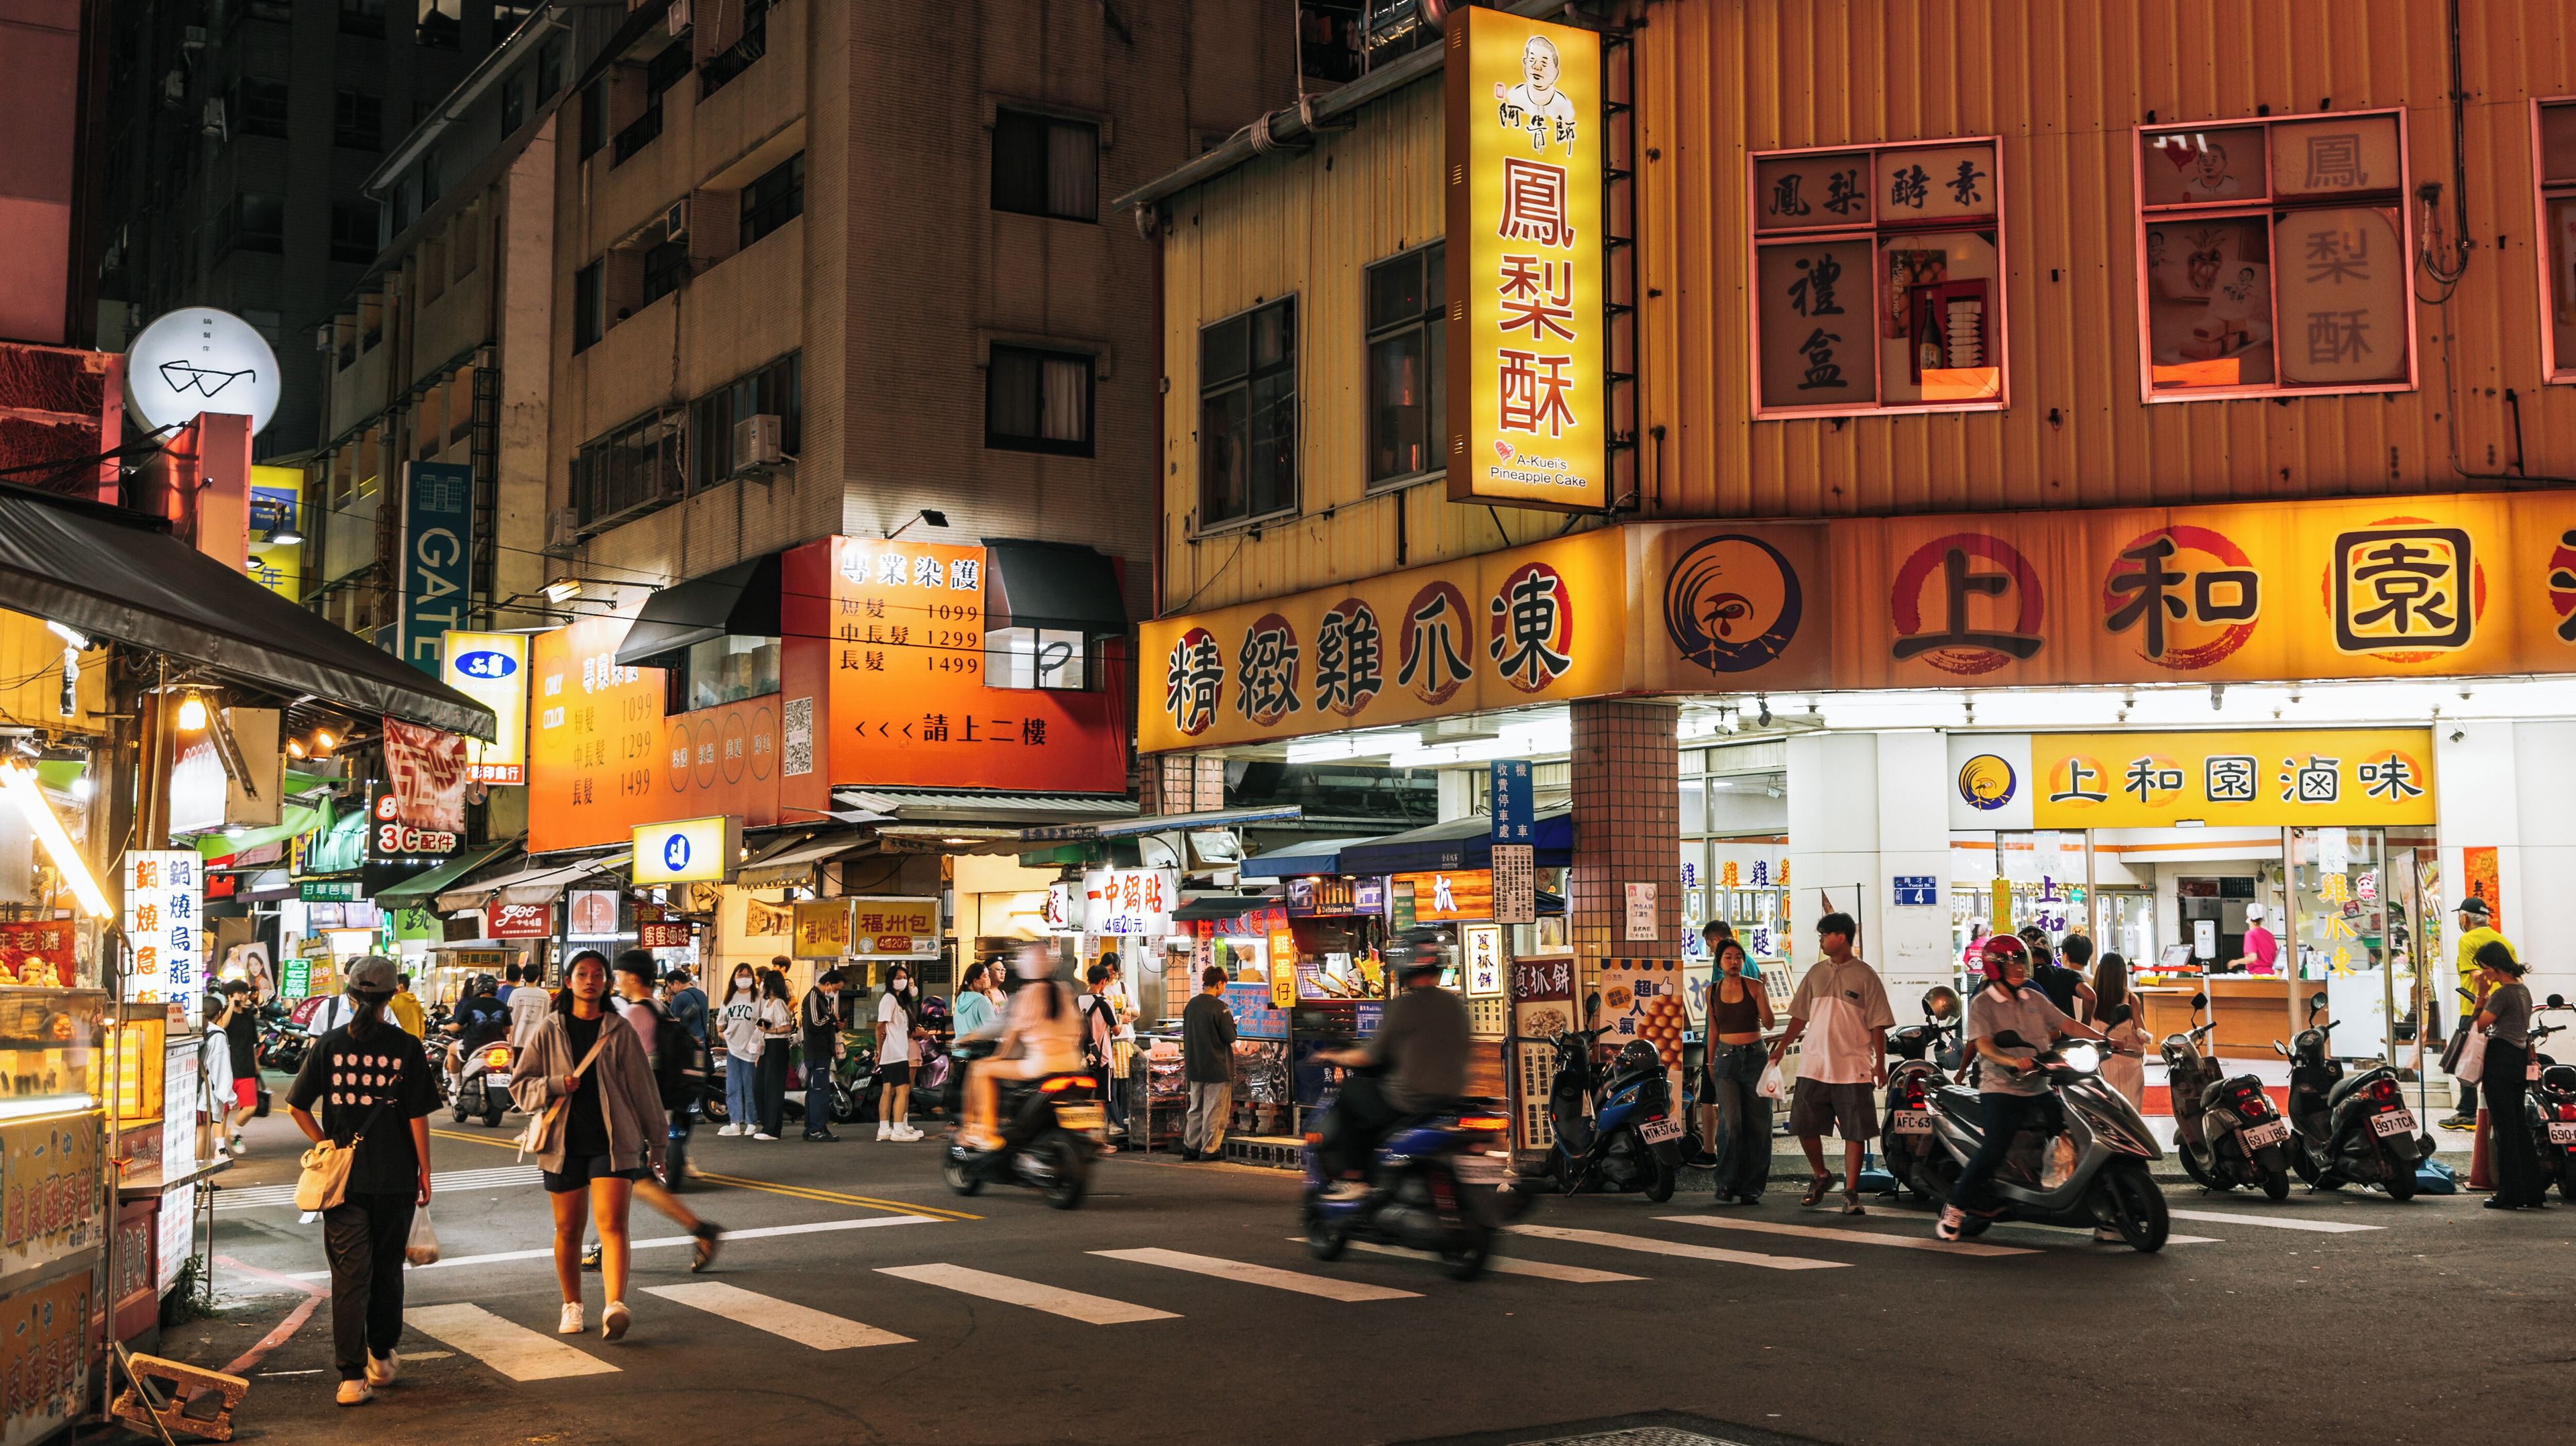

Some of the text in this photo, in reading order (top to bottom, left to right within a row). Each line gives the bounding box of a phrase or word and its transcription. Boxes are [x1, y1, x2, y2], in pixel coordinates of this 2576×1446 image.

[1769, 160, 1988, 216] 鳳梨酵素
[2303, 134, 2373, 365] 鳳梨酥
[1497, 156, 1576, 440] 鳳梨酥
[1787, 253, 1848, 391] 禮盒
[1490, 466, 1587, 488] Pineapple Cake
[1517, 454, 1567, 470] A-Kuei's
[841, 552, 979, 590] 專業染護
[414, 527, 461, 660] GATE
[840, 597, 978, 622] 短髮 1099
[840, 623, 978, 648] 中長髮 1299
[1165, 568, 1572, 732] 精緻雞爪凍
[840, 650, 978, 674] 長髮 1499
[623, 693, 652, 723] 1099
[923, 713, 1047, 745] 請上二樓
[574, 731, 651, 771] 中長髮 1299
[573, 768, 651, 807] 長髮 1499
[2047, 753, 2426, 805] 上和園滷味
[1497, 763, 1509, 838] 收費停車處
[1515, 764, 1528, 838] 機車
[380, 824, 456, 853] 3C配件
[303, 884, 353, 896] 甘草芭樂
[1721, 861, 1740, 890] 雞
[1087, 874, 1162, 914] 一中鍋貼
[1915, 889, 1924, 904] 4
[1996, 882, 2006, 933] 禁帶外
[136, 860, 158, 1003] 鍋燒意麵
[644, 925, 689, 945] 蛋蛋滷味
[805, 918, 841, 944] 福州包
[861, 913, 930, 933] 福州包
[1102, 915, 1146, 933] (4個20元)
[2317, 872, 2357, 980] 雞爪凍
[1273, 935, 1291, 1001] 雞蛋仔
[727, 1004, 753, 1021] NYC
[1619, 979, 1652, 1035] 超人氣
[1643, 1123, 1680, 1140] MTM-3766
[1896, 1116, 1931, 1129] AFC-63
[2247, 1125, 2288, 1147] 697-TBG
[2375, 1113, 2416, 1134] 997-TCA
[6, 1165, 92, 1249] 脆皮雞蛋糕
